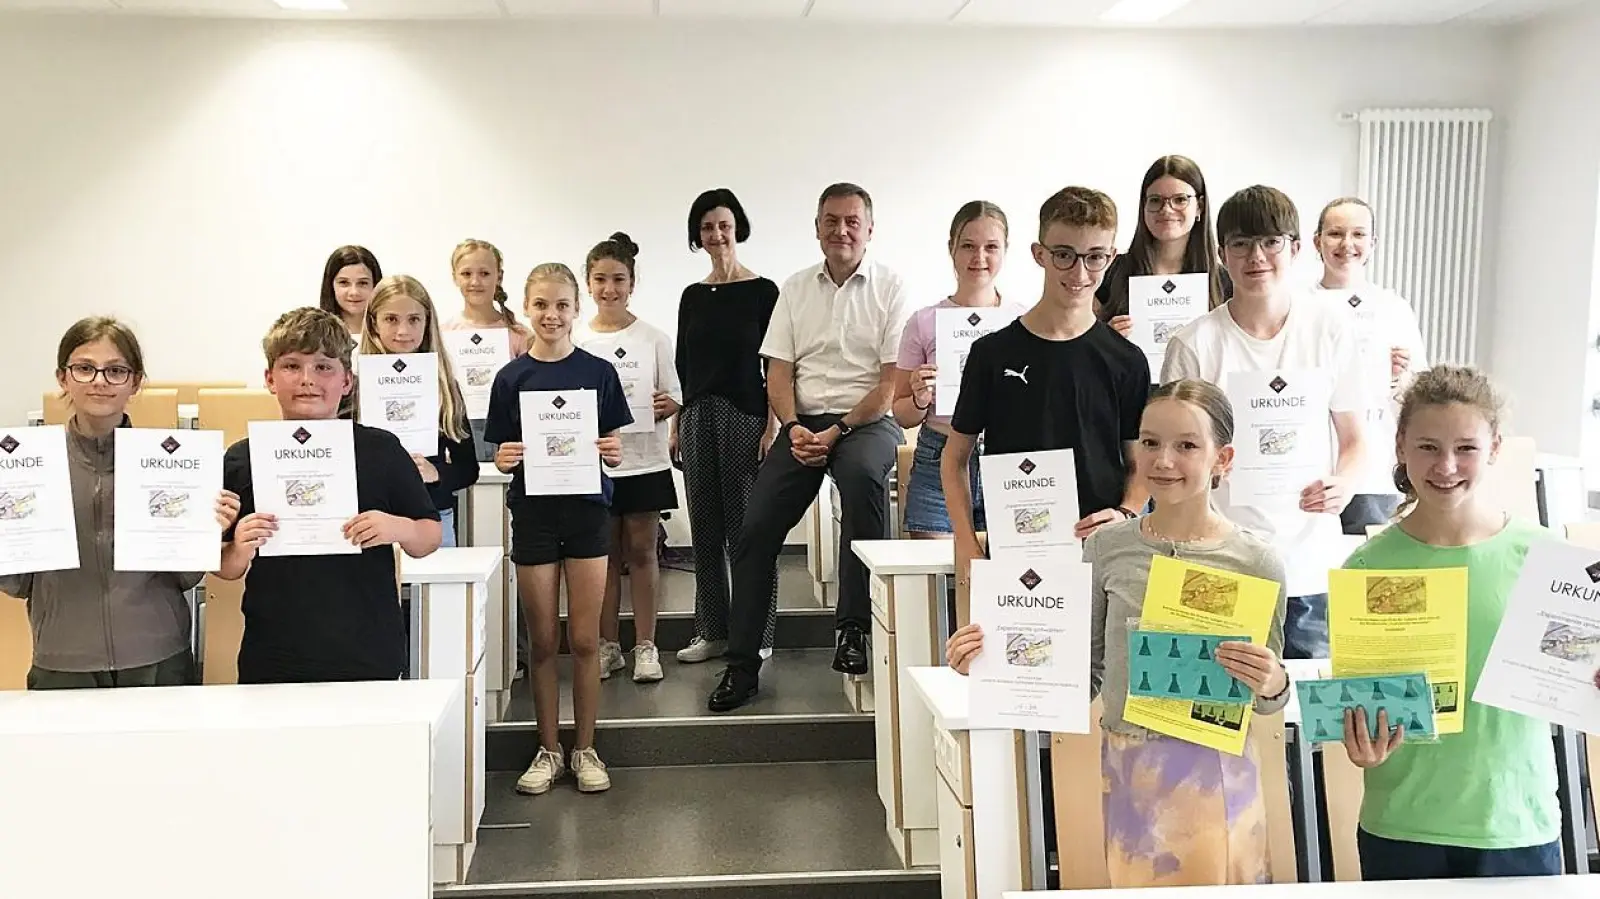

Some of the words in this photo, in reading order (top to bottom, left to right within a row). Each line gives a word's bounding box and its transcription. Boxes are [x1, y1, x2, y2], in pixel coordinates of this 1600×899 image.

[1147, 296, 1191, 306] URKUNDE
[459, 346, 496, 355] URKUNDE
[377, 375, 422, 385] URKUNDE
[1250, 396, 1306, 409] URKUNDE
[538, 411, 582, 420] URKUNDE
[274, 447, 332, 460] URKUNDE
[140, 457, 201, 470] URKUNDE
[1003, 476, 1056, 490] URKUNDE
[997, 594, 1065, 609] URKUNDE
